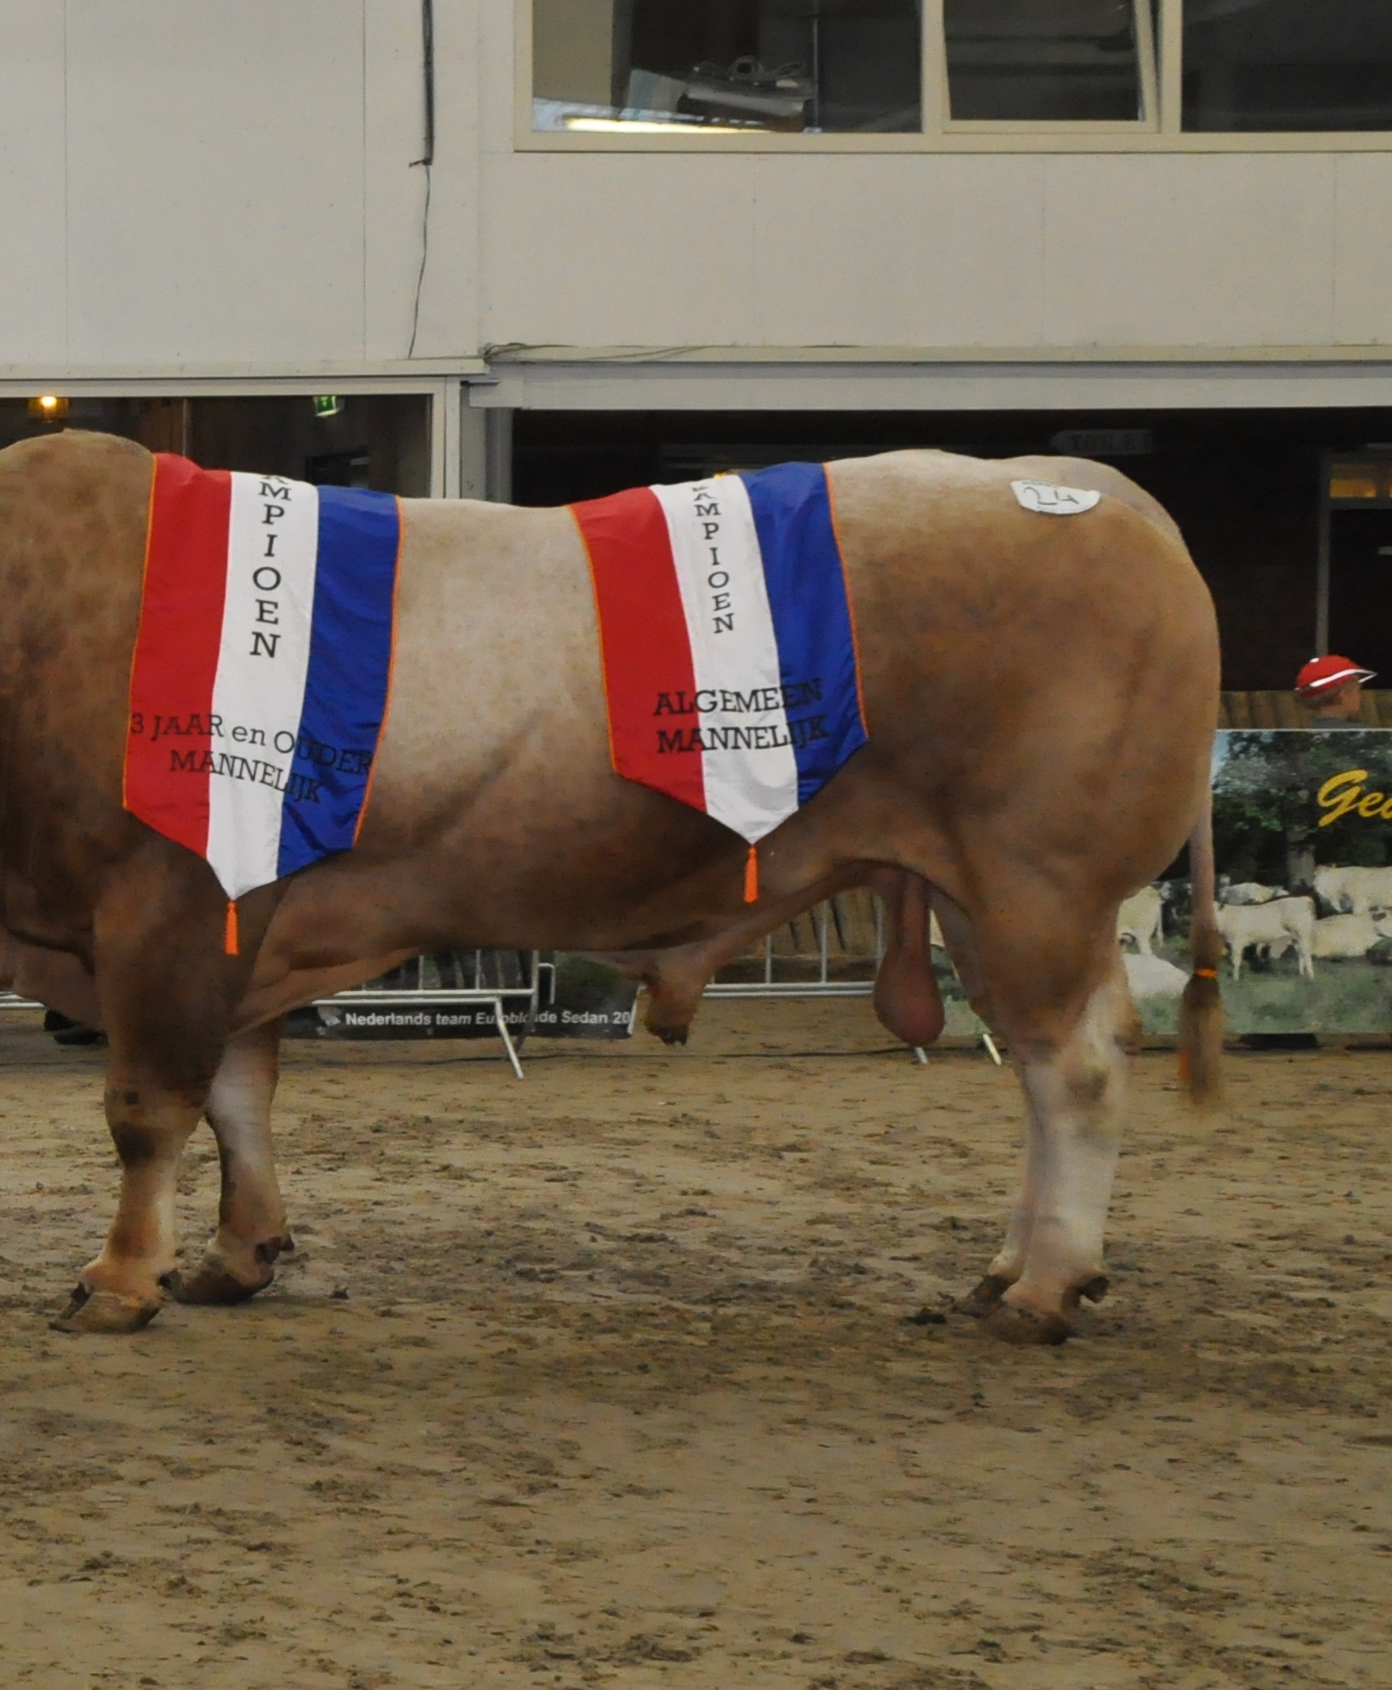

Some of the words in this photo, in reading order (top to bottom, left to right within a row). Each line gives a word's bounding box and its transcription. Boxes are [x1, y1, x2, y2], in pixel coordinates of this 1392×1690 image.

[652, 678, 824, 716] ALGEMEEN
[130, 712, 145, 734] 3
[150, 714, 224, 742] JAAR
[231, 723, 266, 747] en
[274, 730, 373, 776] OUDER
[656, 715, 830, 754] MANNELIJK
[169, 750, 321, 803] MANNELIJK
[346, 1012, 431, 1026] Nederlands
[436, 1013, 472, 1025] team
[475, 1012, 557, 1026] Euoblode
[561, 1010, 608, 1024] Sedan
